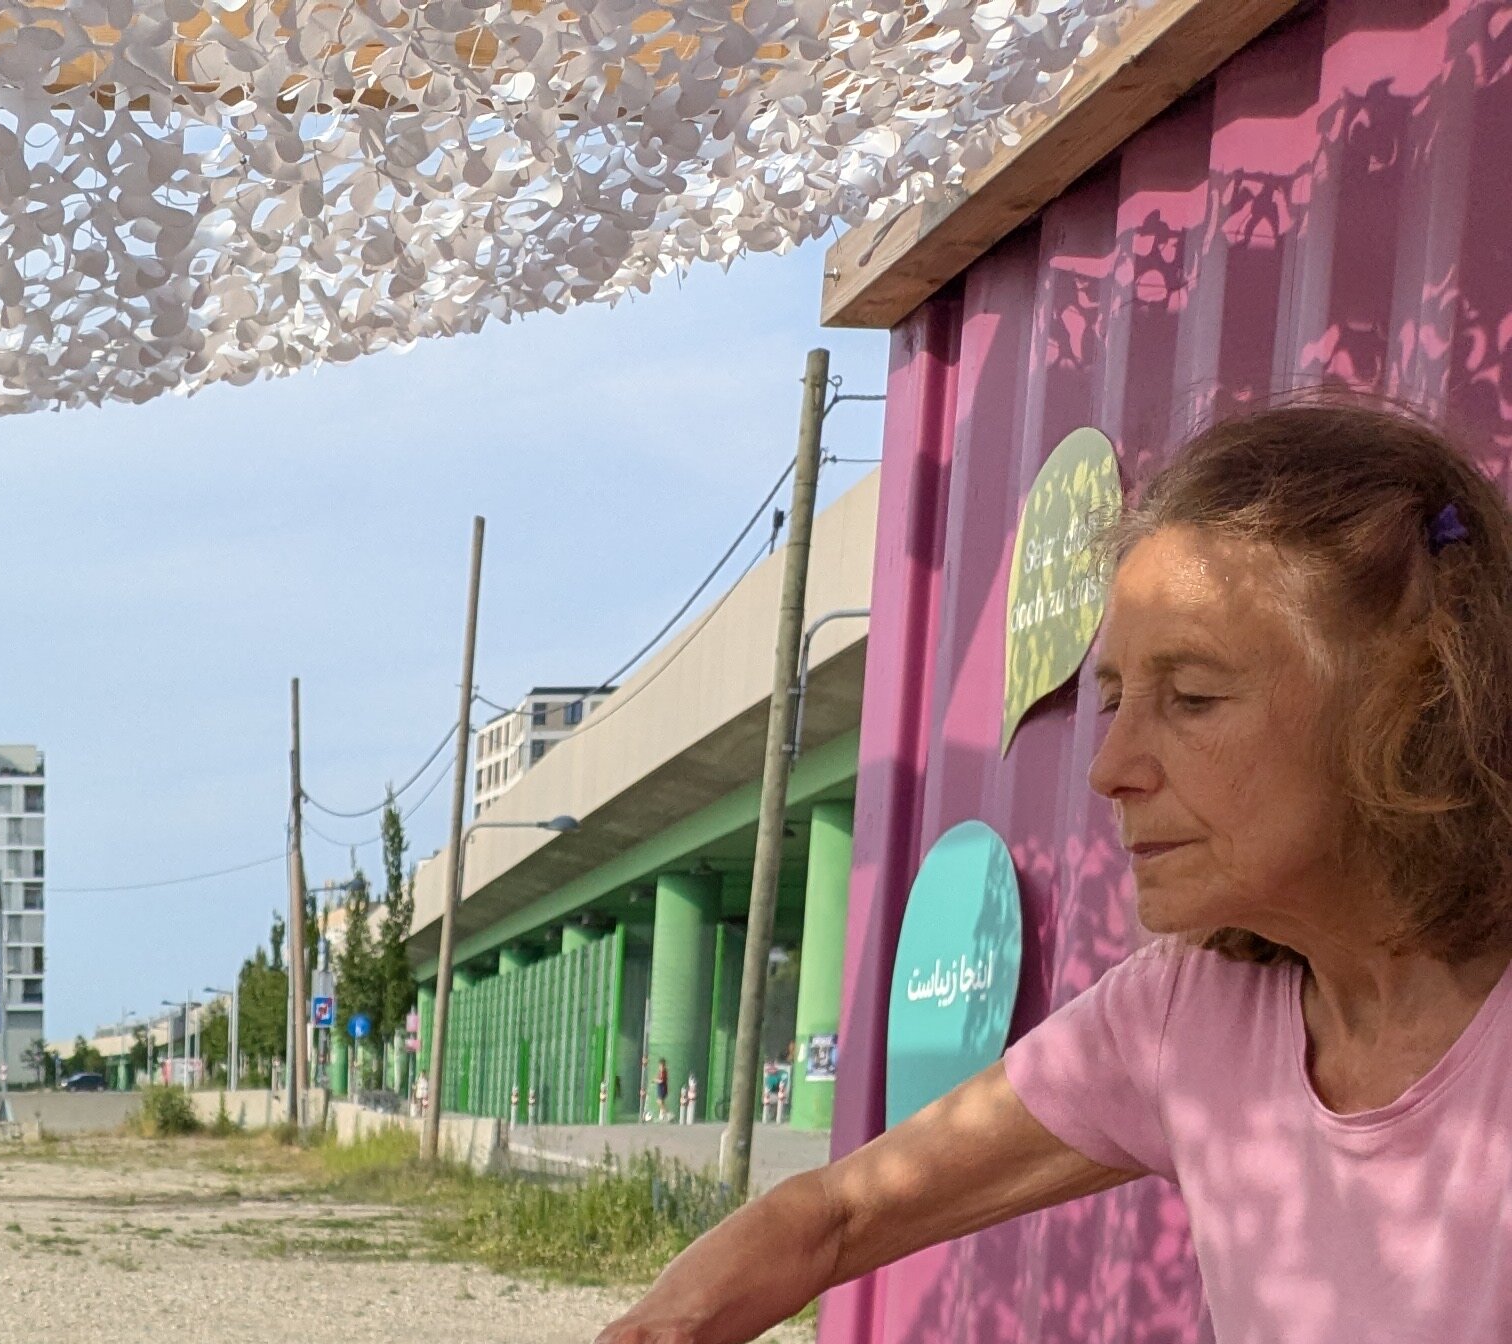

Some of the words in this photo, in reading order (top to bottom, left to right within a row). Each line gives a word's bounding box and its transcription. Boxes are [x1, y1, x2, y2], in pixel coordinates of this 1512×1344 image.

[1011, 584, 1044, 633] doch
[1048, 587, 1065, 617] zu
[959, 949, 993, 1003] اینجا
